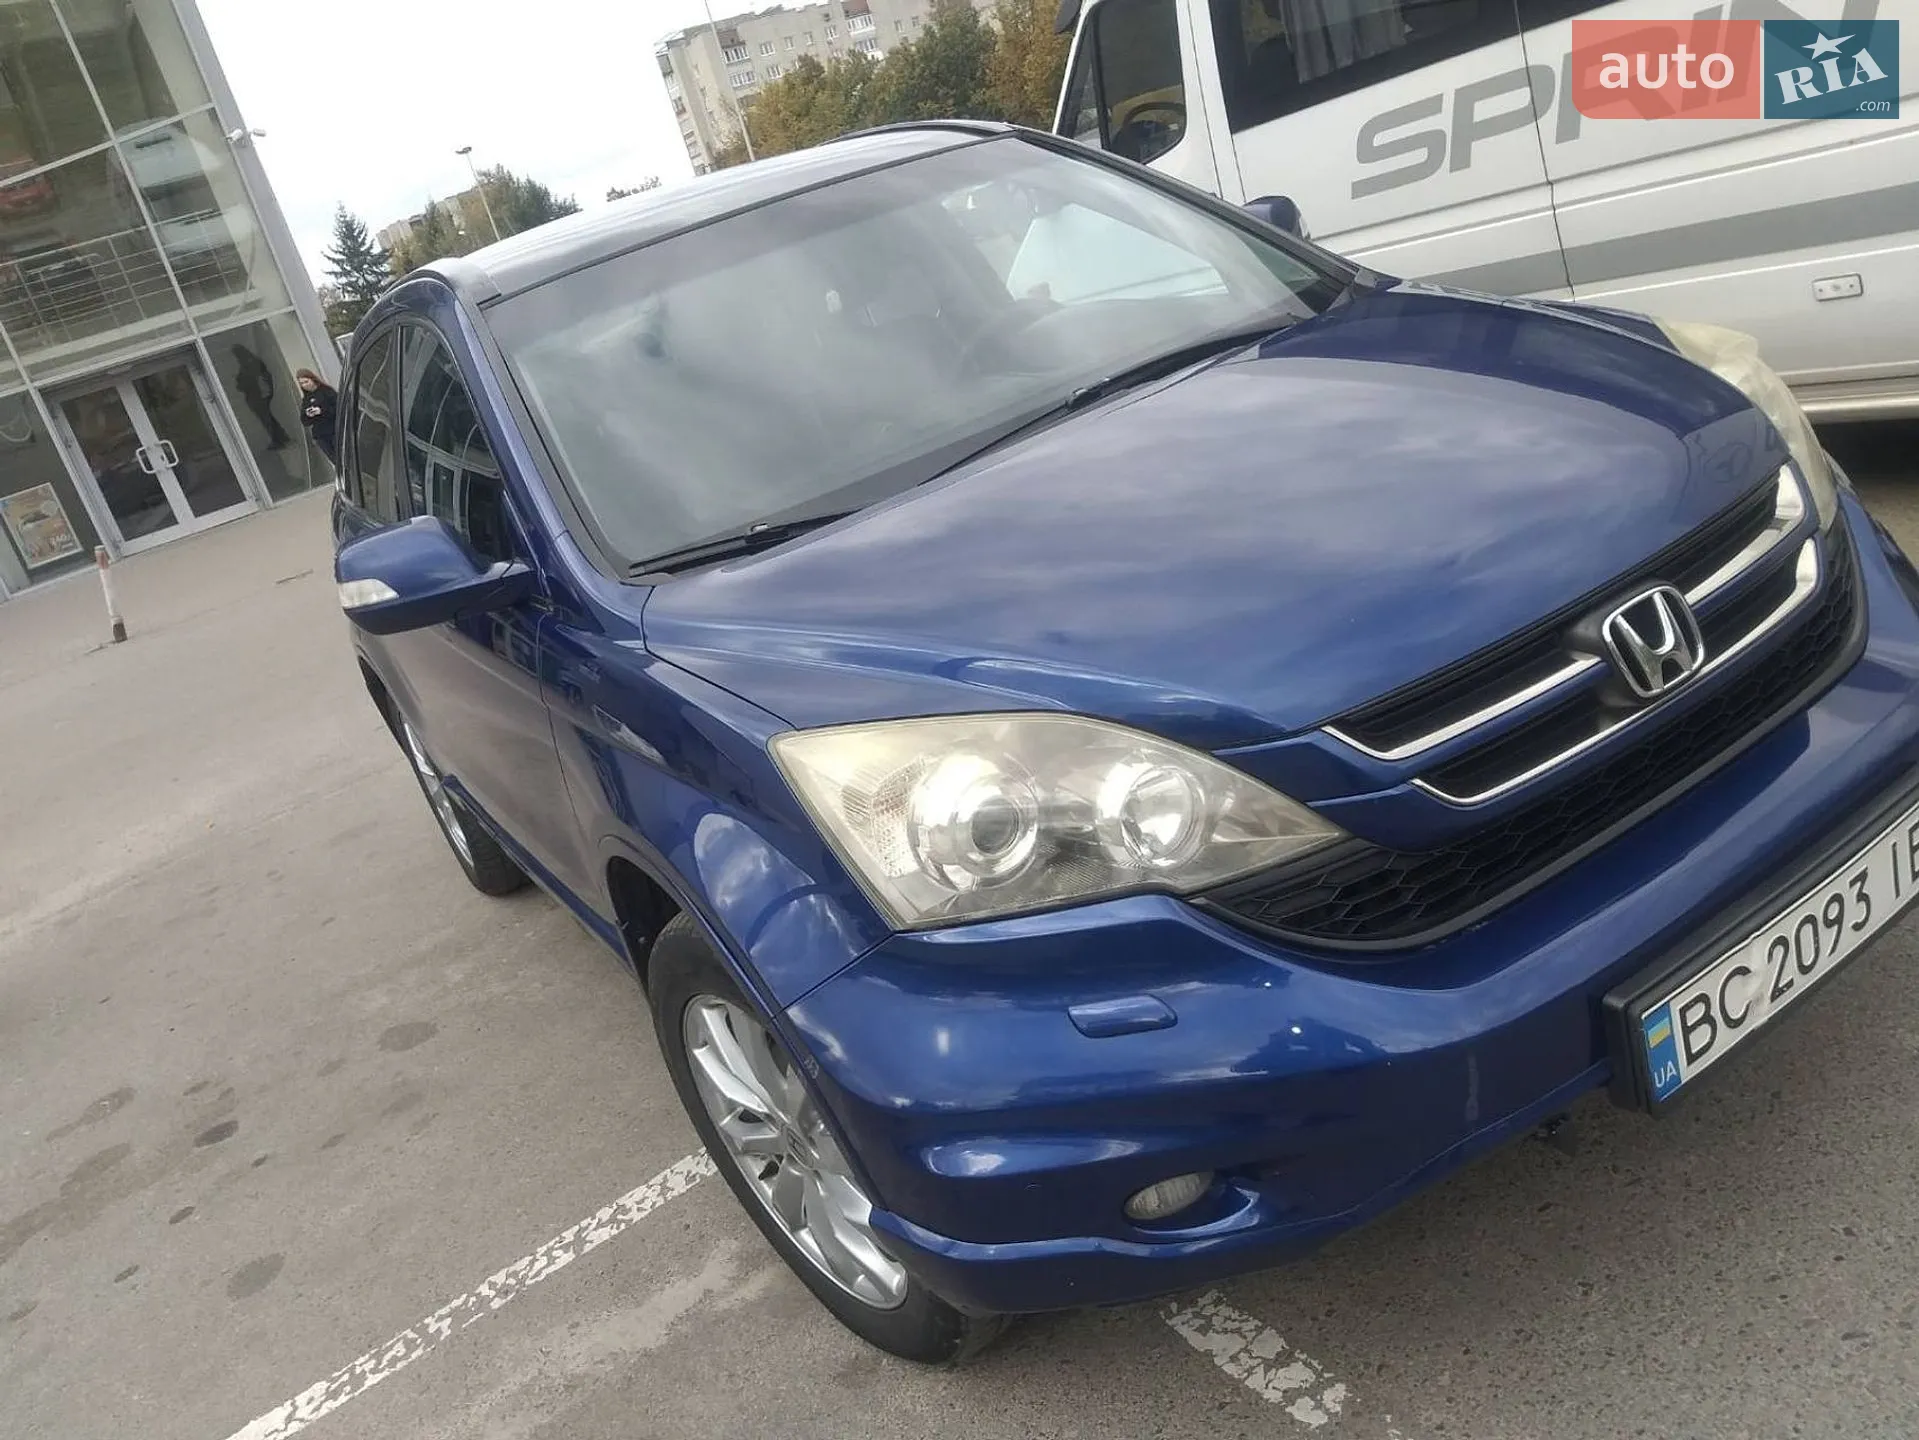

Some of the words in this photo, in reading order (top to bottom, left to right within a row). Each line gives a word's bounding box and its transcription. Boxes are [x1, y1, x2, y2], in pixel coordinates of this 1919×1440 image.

[1679, 966, 1752, 1066] BC
[1767, 865, 1871, 1002] 2093
[1654, 1060, 1677, 1088] UA
